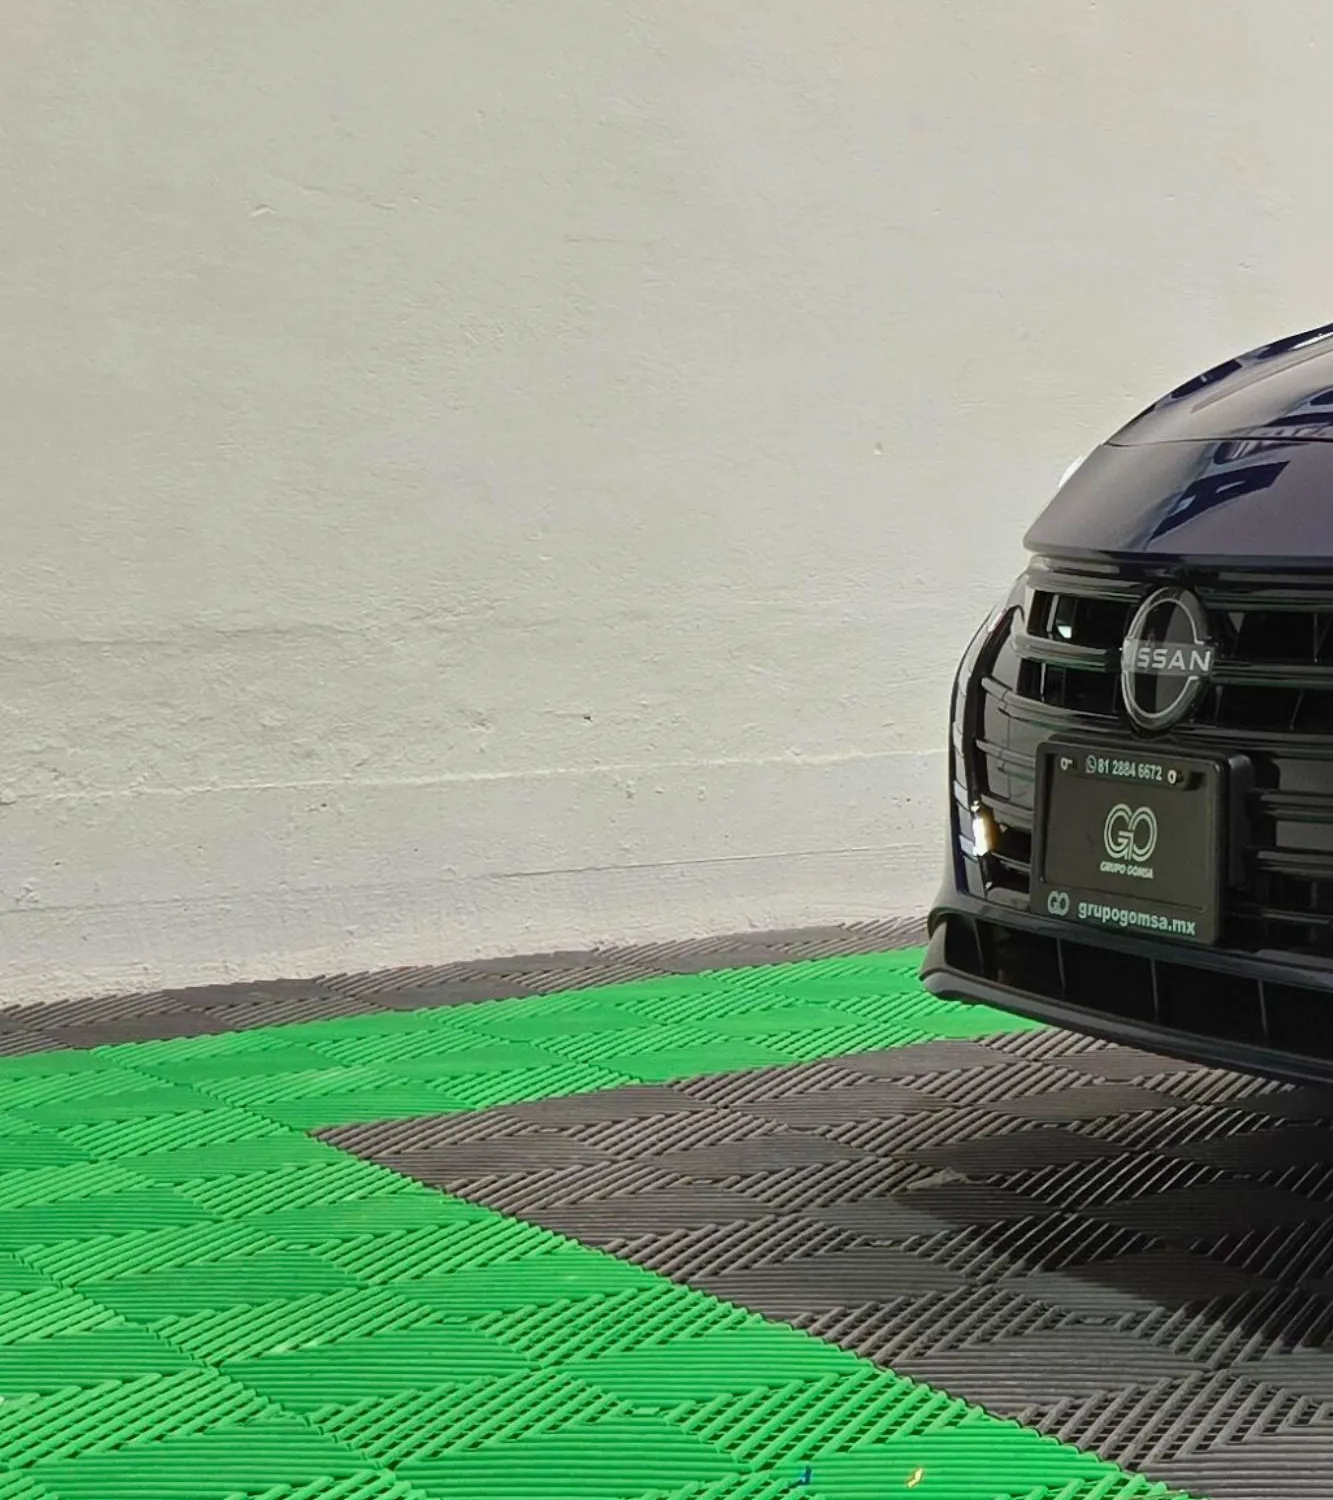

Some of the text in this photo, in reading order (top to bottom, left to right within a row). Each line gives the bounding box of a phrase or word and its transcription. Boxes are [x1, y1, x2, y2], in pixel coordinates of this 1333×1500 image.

[1126, 642, 1211, 672] SSAN
[1098, 758, 1109, 774] 81
[1100, 861, 1127, 875] GRUPO
[1078, 902, 1196, 936] grupogomsa.mx
